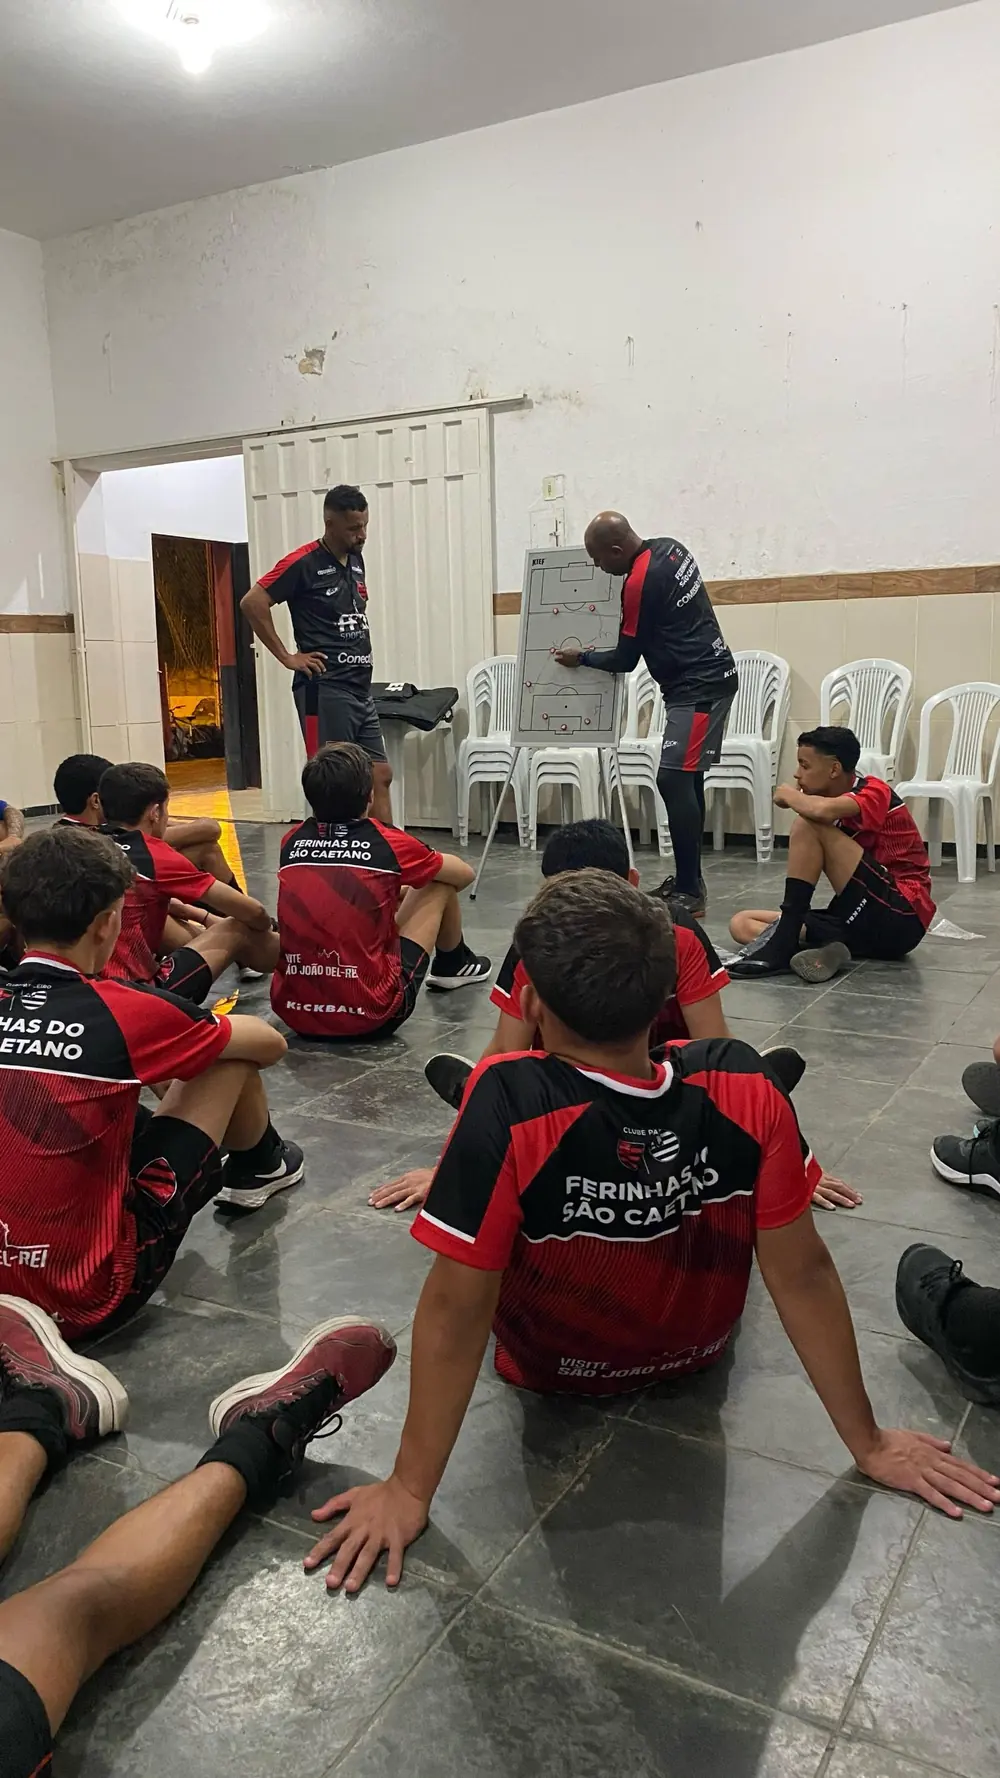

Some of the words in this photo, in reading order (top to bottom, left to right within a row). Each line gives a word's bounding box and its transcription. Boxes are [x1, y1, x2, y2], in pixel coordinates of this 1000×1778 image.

[294, 840, 348, 848] FERINHAS
[351, 840, 370, 848] DO
[288, 848, 308, 859] SÃO
[311, 850, 372, 860] CAETANO
[300, 963, 324, 976] JOÃO
[46, 1020, 84, 1038] DO
[0, 1038, 83, 1060] ETANO
[623, 1126, 646, 1136] CLUBE
[566, 1164, 692, 1202] FERINHAS
[562, 1196, 616, 1224] SÃO
[560, 1357, 612, 1370] VISITE
